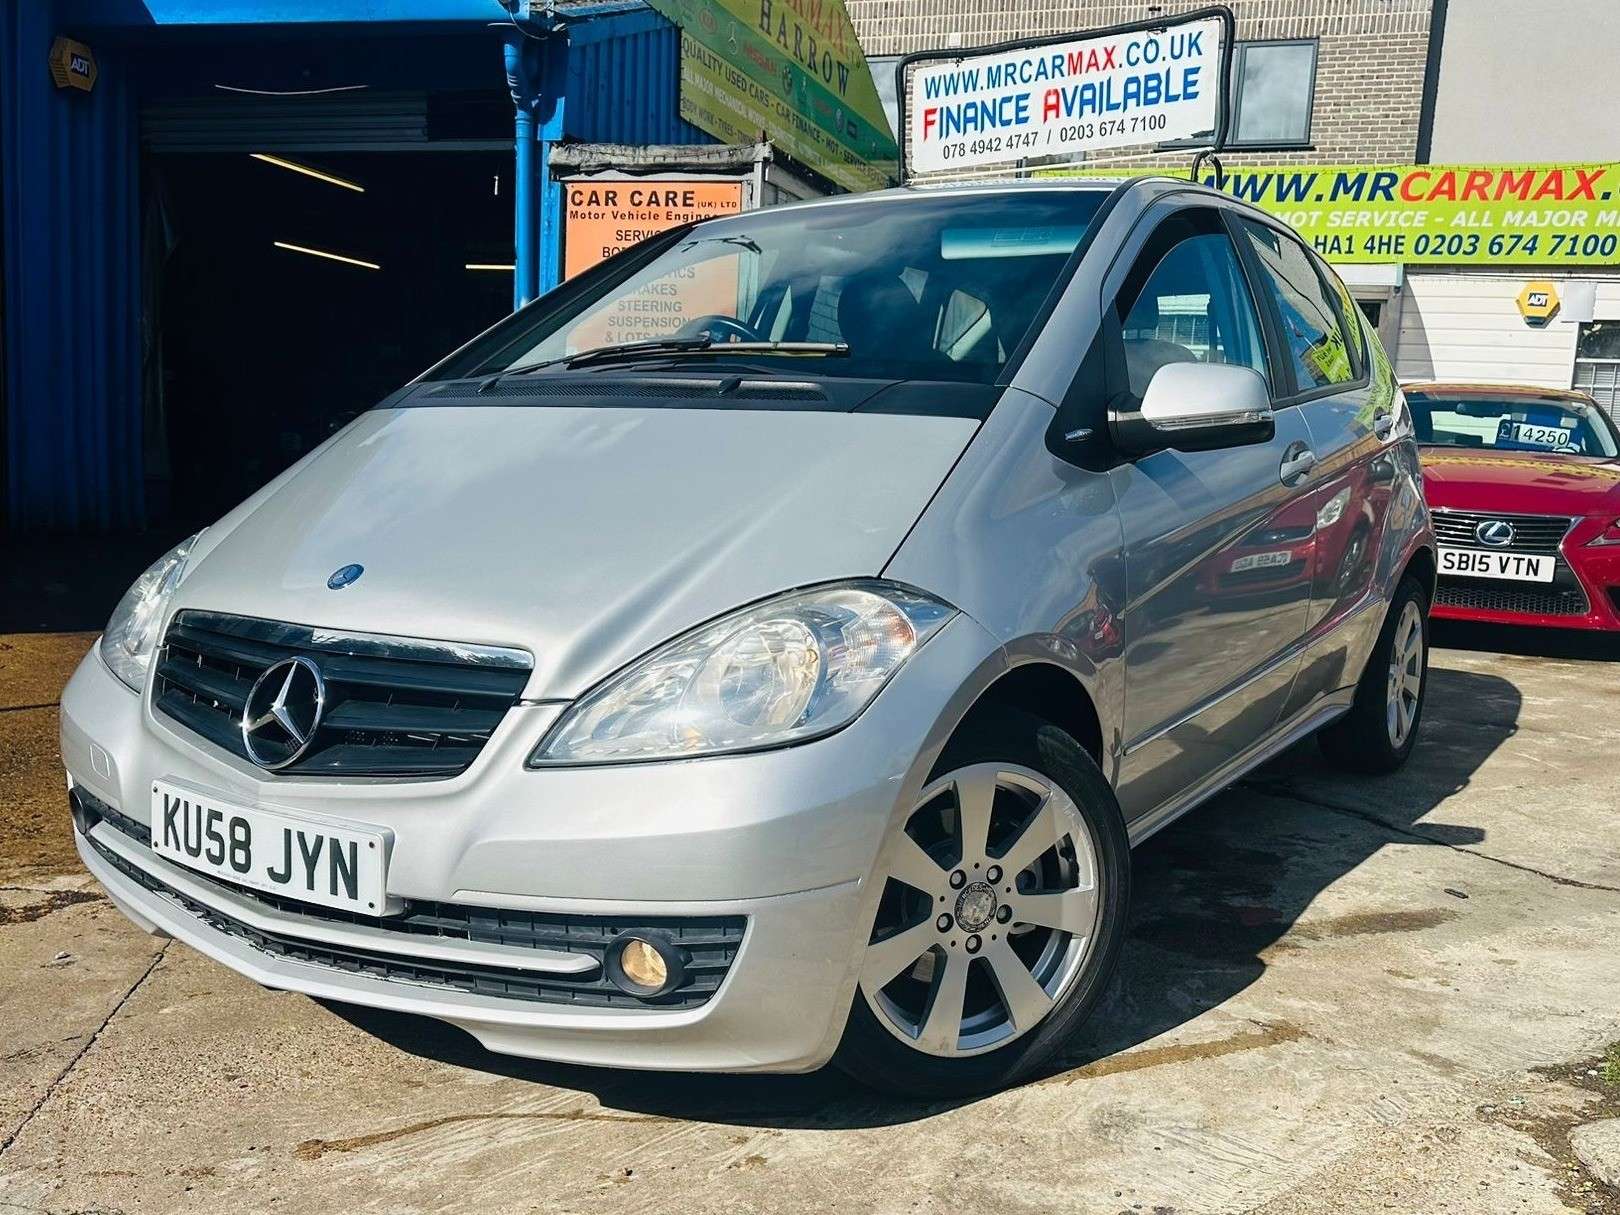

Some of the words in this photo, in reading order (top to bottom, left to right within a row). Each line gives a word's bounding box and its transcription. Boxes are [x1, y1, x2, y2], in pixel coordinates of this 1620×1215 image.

[759, 0, 850, 97] HARROW
[71, 56, 89, 75] ADT
[683, 38, 723, 76] QUALITY
[725, 66, 747, 92] USED
[749, 83, 769, 108] CARS
[925, 31, 1203, 100] WWW.MRCARMAX.CO.UK
[923, 92, 1031, 142] FINANCE
[1043, 66, 1201, 124] AVAILABLE
[943, 140, 966, 160] 078
[969, 135, 1002, 156] 4942
[1006, 131, 1038, 151] 4747
[1060, 124, 1094, 142] 0203
[1099, 119, 1126, 137] 674
[1130, 113, 1166, 133] 7100
[1203, 168, 1620, 203] WW.MRCARMAX.
[570, 190, 618, 207] CAR
[630, 190, 695, 207] CARE
[697, 201, 717, 209] (UK)
[569, 210, 605, 220] Motor
[612, 210, 660, 221] Vehicle
[1327, 210, 1428, 228] SERVICE
[1450, 210, 1494, 228] ALL
[1502, 210, 1588, 228] MAJOR
[1314, 235, 1354, 255] HA1
[1364, 235, 1404, 255] 4HE
[1414, 233, 1480, 256] 0203
[1488, 233, 1539, 256] 674
[1548, 233, 1617, 256] 7100
[618, 300, 683, 313] STEERING
[1529, 293, 1548, 306] ADT
[1443, 552, 1491, 573] SB15
[1500, 556, 1540, 577] VTN
[164, 793, 252, 874] KU58
[267, 828, 358, 901] JYN
